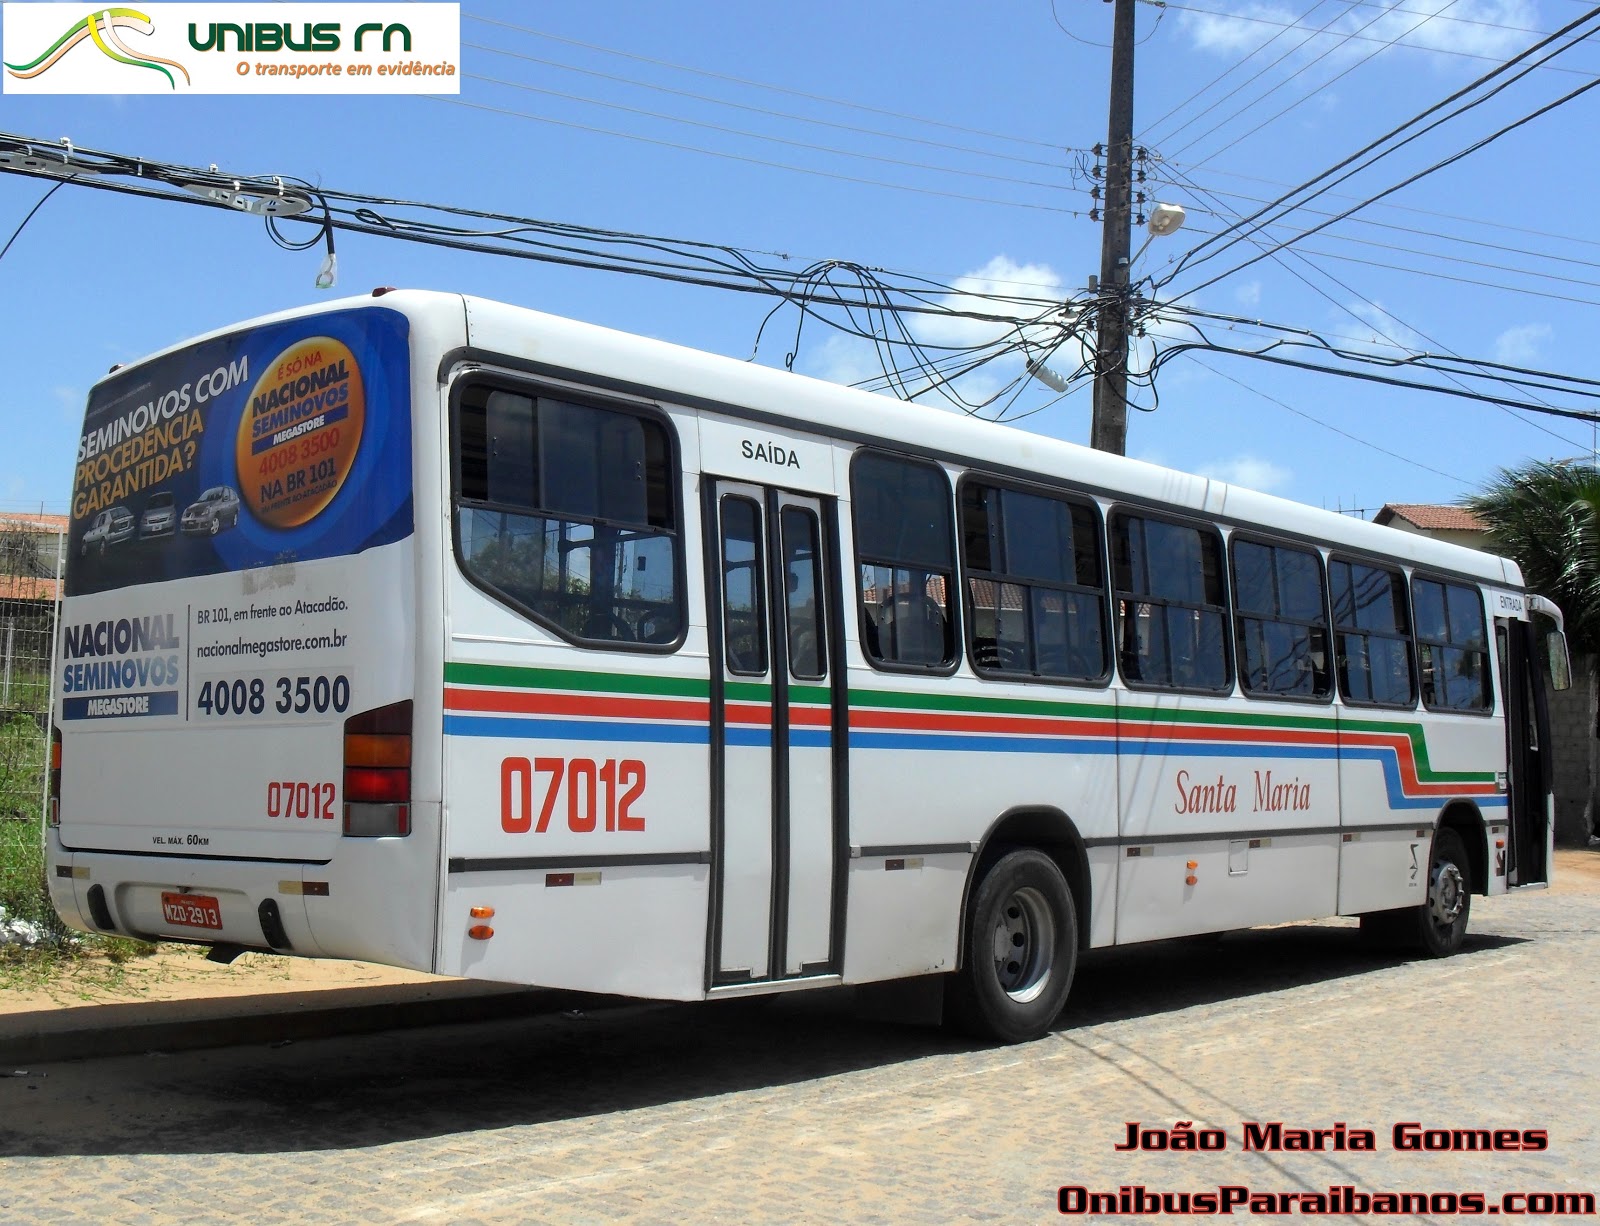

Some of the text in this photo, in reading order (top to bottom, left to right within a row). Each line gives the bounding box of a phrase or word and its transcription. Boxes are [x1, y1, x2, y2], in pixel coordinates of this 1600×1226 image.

[278, 351, 322, 381] É SÓ NA
[78, 383, 192, 463] SEMINOVOS
[195, 355, 248, 403] COM
[253, 359, 350, 418] NACIONAL
[252, 382, 348, 438] SEMINOVOS
[273, 415, 325, 445] MEGASTORE
[75, 408, 204, 491] PROCEDÊNCIA
[259, 427, 340, 476] 4008 3500
[741, 439, 801, 470] SAÍDA
[261, 457, 337, 504] NA BR 101
[197, 595, 348, 625] BR 101, em frente ao Atacadão.
[1500, 595, 1522, 612] ENTRADA
[64, 614, 180, 660] NACIONAL
[197, 628, 348, 658] nacionalmegastore.com.br
[63, 655, 179, 693] SEMINOVOS
[87, 696, 149, 716] MEGASTORE
[198, 675, 351, 716] 4008 3500
[267, 781, 336, 820] 07012
[500, 756, 646, 834] 07012
[1174, 769, 1310, 815] Santa Maria
